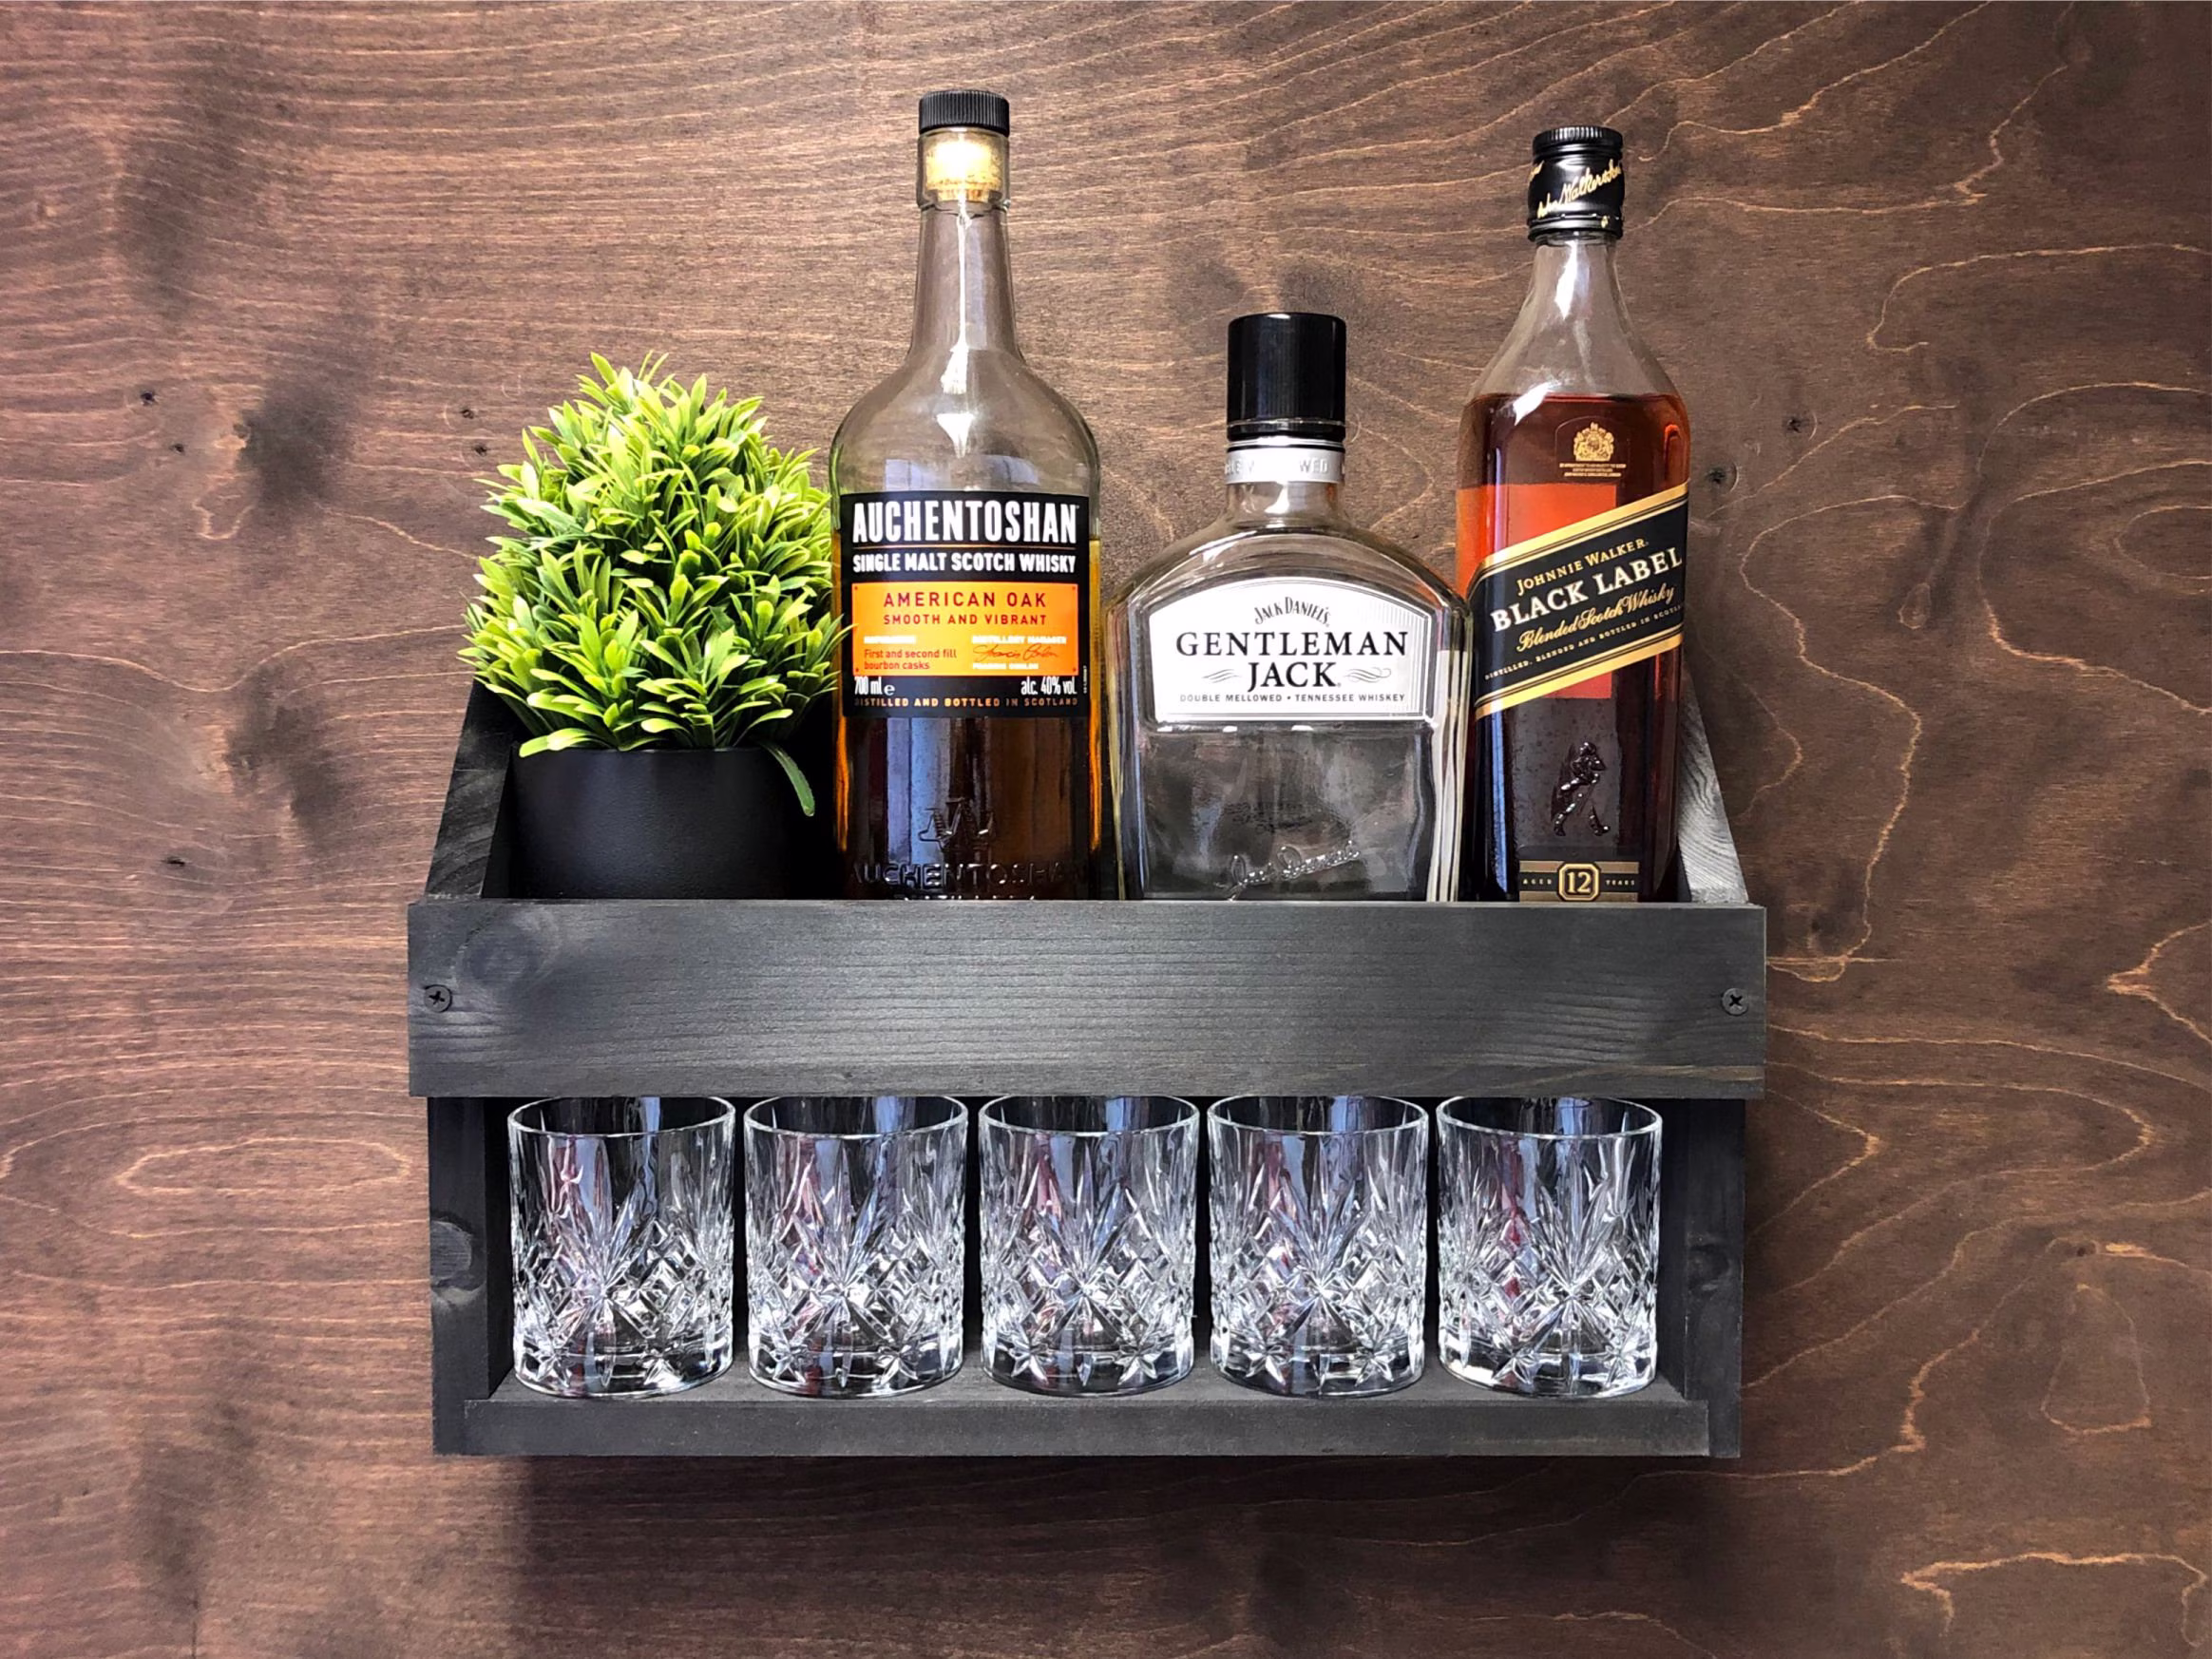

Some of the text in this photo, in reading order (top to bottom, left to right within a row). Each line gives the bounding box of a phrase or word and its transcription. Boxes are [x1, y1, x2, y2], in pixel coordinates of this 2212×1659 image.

[852, 500, 1077, 543] AUCHENTOSHAN
[853, 553, 1076, 573] SINGLE MALT SCOTCH WHISKY
[1516, 538, 1647, 596] JOHNNIE WALKER
[1490, 546, 1683, 633] BLACK LABEL
[884, 592, 1046, 607] AMERICAN OAK
[884, 614, 1047, 625] SMOOTH AND VIBRANT
[1516, 582, 1675, 652] Blended Scotch Whisky
[1176, 631, 1408, 657] GENTLEMAN
[1577, 636, 1596, 647] AND
[864, 648, 958, 658] First and second fill
[864, 660, 930, 670] bourbon casks
[1040, 676, 1061, 695] 40%
[1248, 660, 1337, 693] JACK
[914, 698, 939, 707] AND
[944, 698, 1001, 707] BOTTLED
[1024, 697, 1077, 706] SCOTLAND
[1179, 694, 1405, 702] DOUBLE MELLOWED TENNESSEE WHISKEY
[1566, 871, 1592, 893] 12
